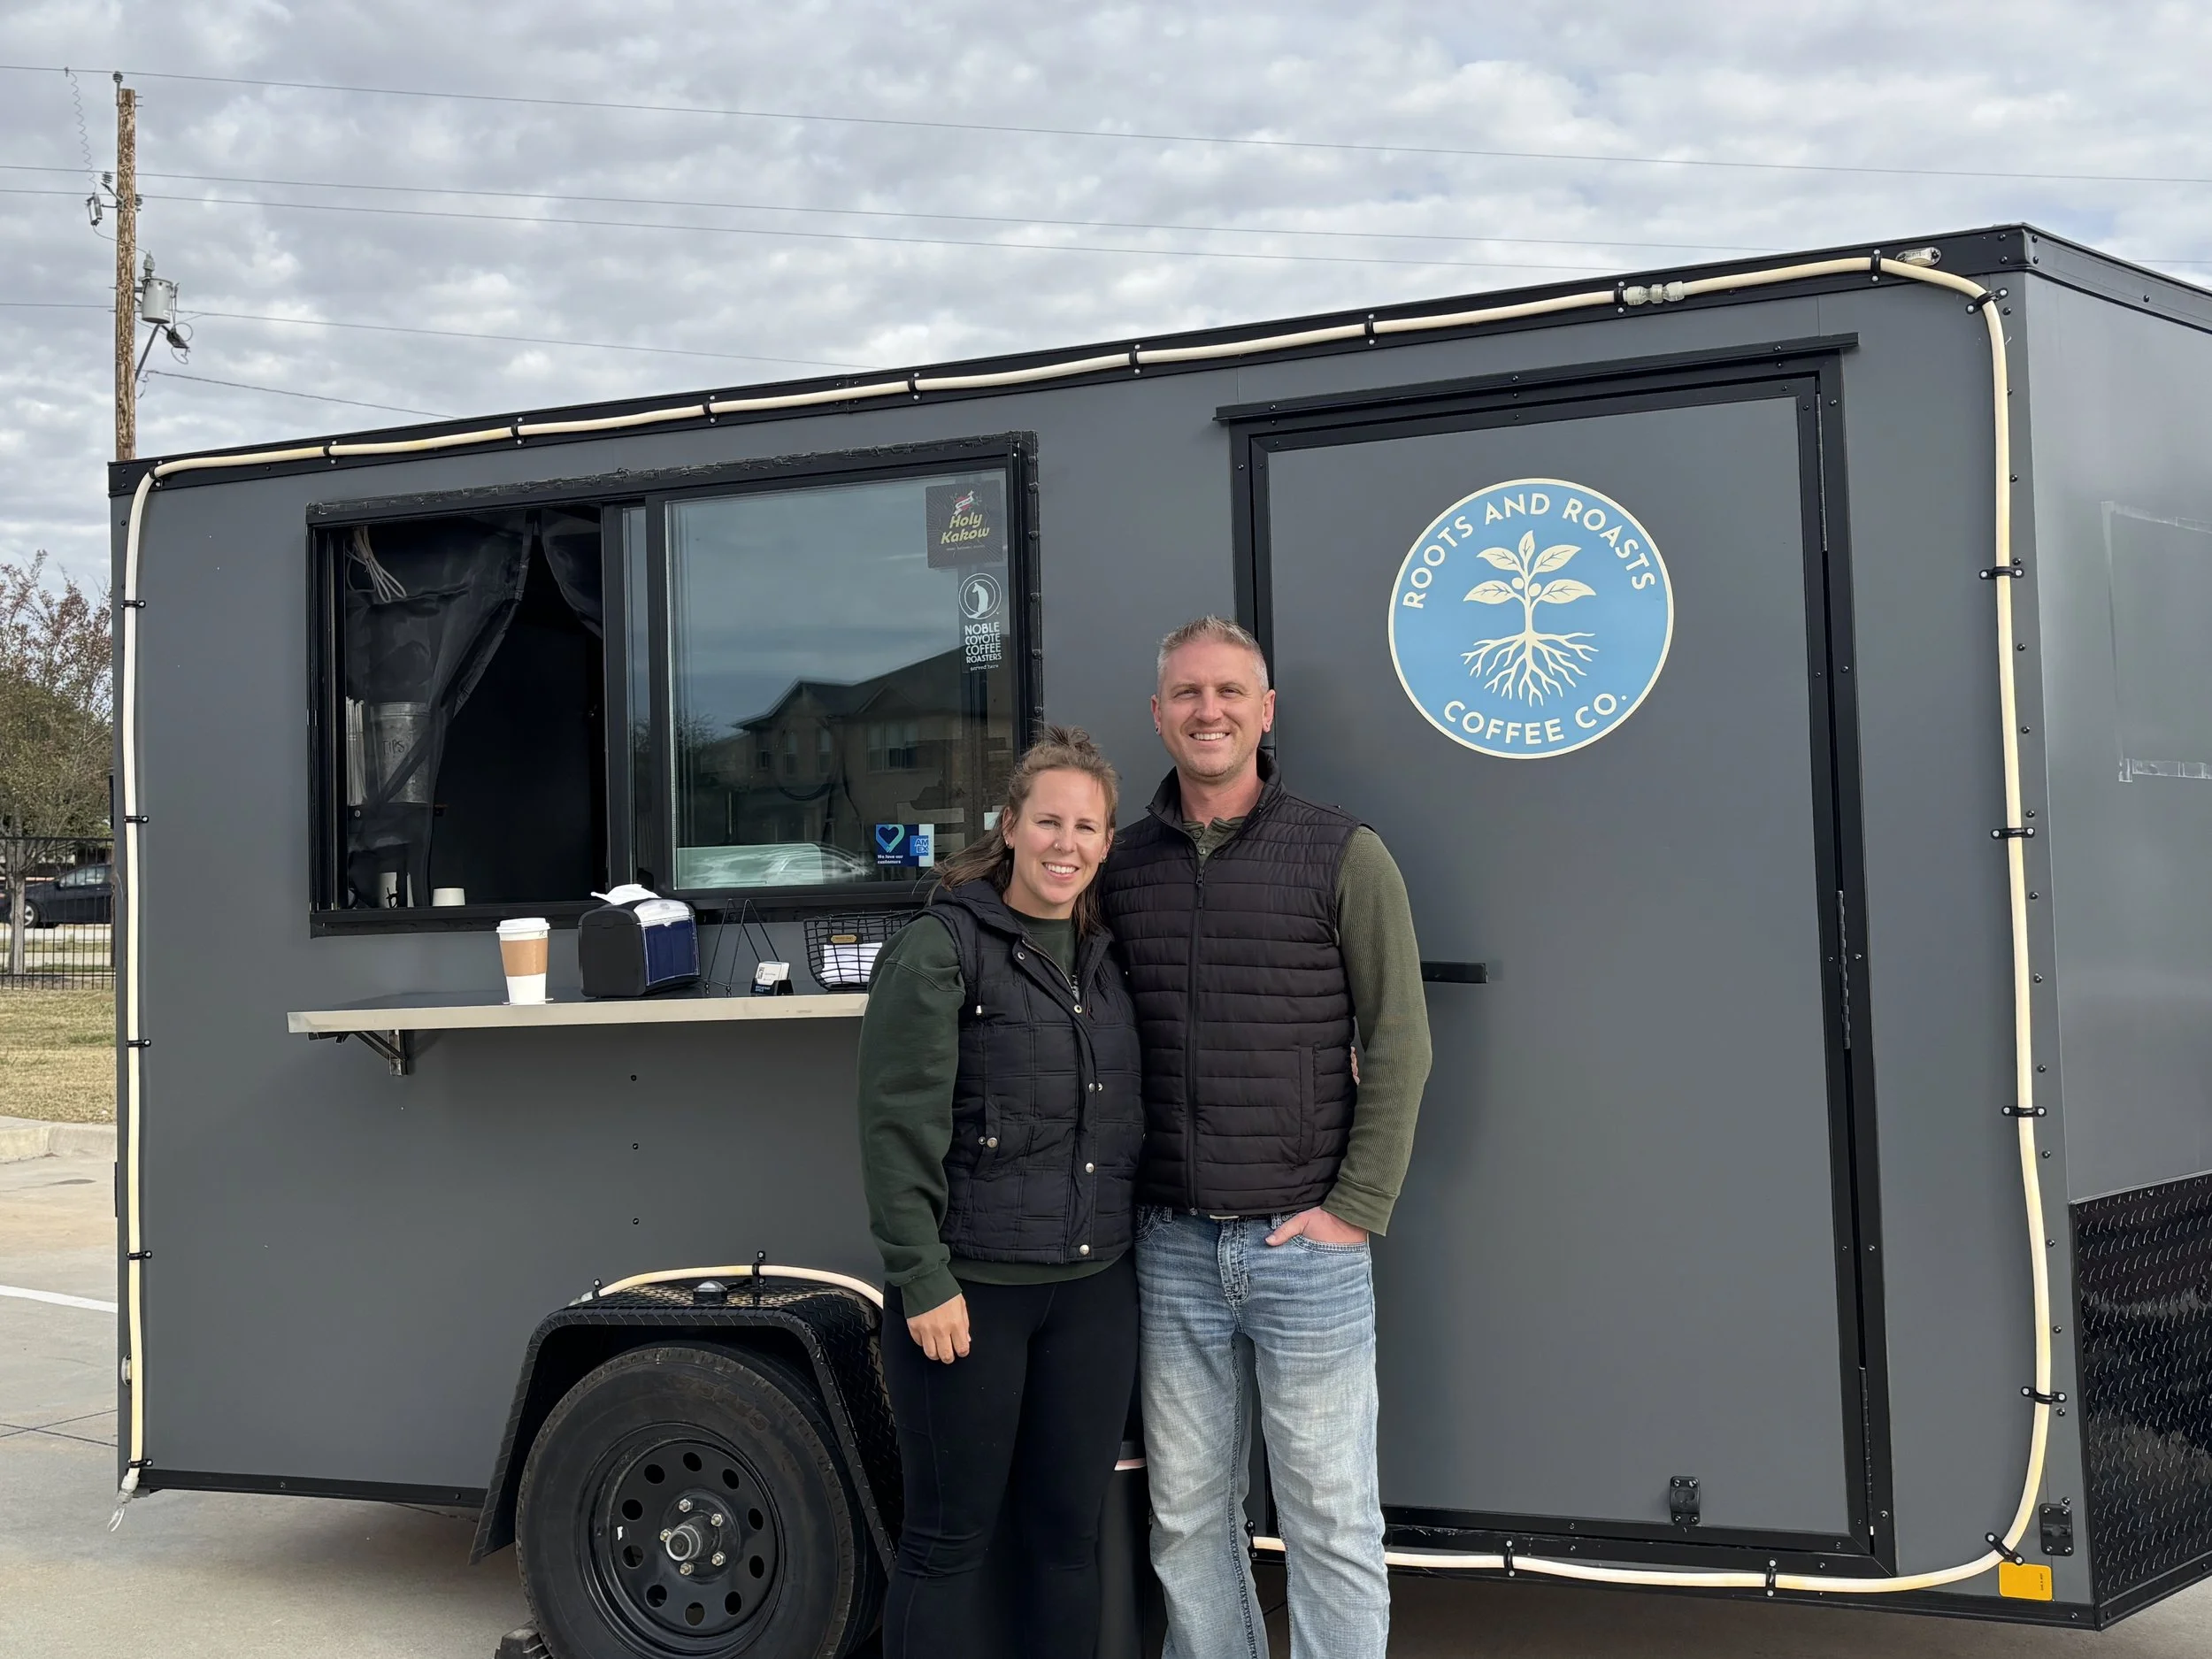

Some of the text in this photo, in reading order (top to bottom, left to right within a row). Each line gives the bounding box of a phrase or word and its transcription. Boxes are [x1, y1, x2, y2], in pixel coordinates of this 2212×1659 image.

[949, 512, 983, 529] Holy
[941, 526, 989, 544] Kakow
[1402, 493, 1655, 609] ROOTS AND ROASTS
[964, 622, 1000, 635] NOBLE
[964, 633, 1001, 646] COYOTE
[965, 643, 1002, 656] COFFEE
[966, 653, 1002, 664] ROASTERS
[1444, 693, 1627, 744] COFFEE CO.
[382, 739, 404, 755] TIPS
